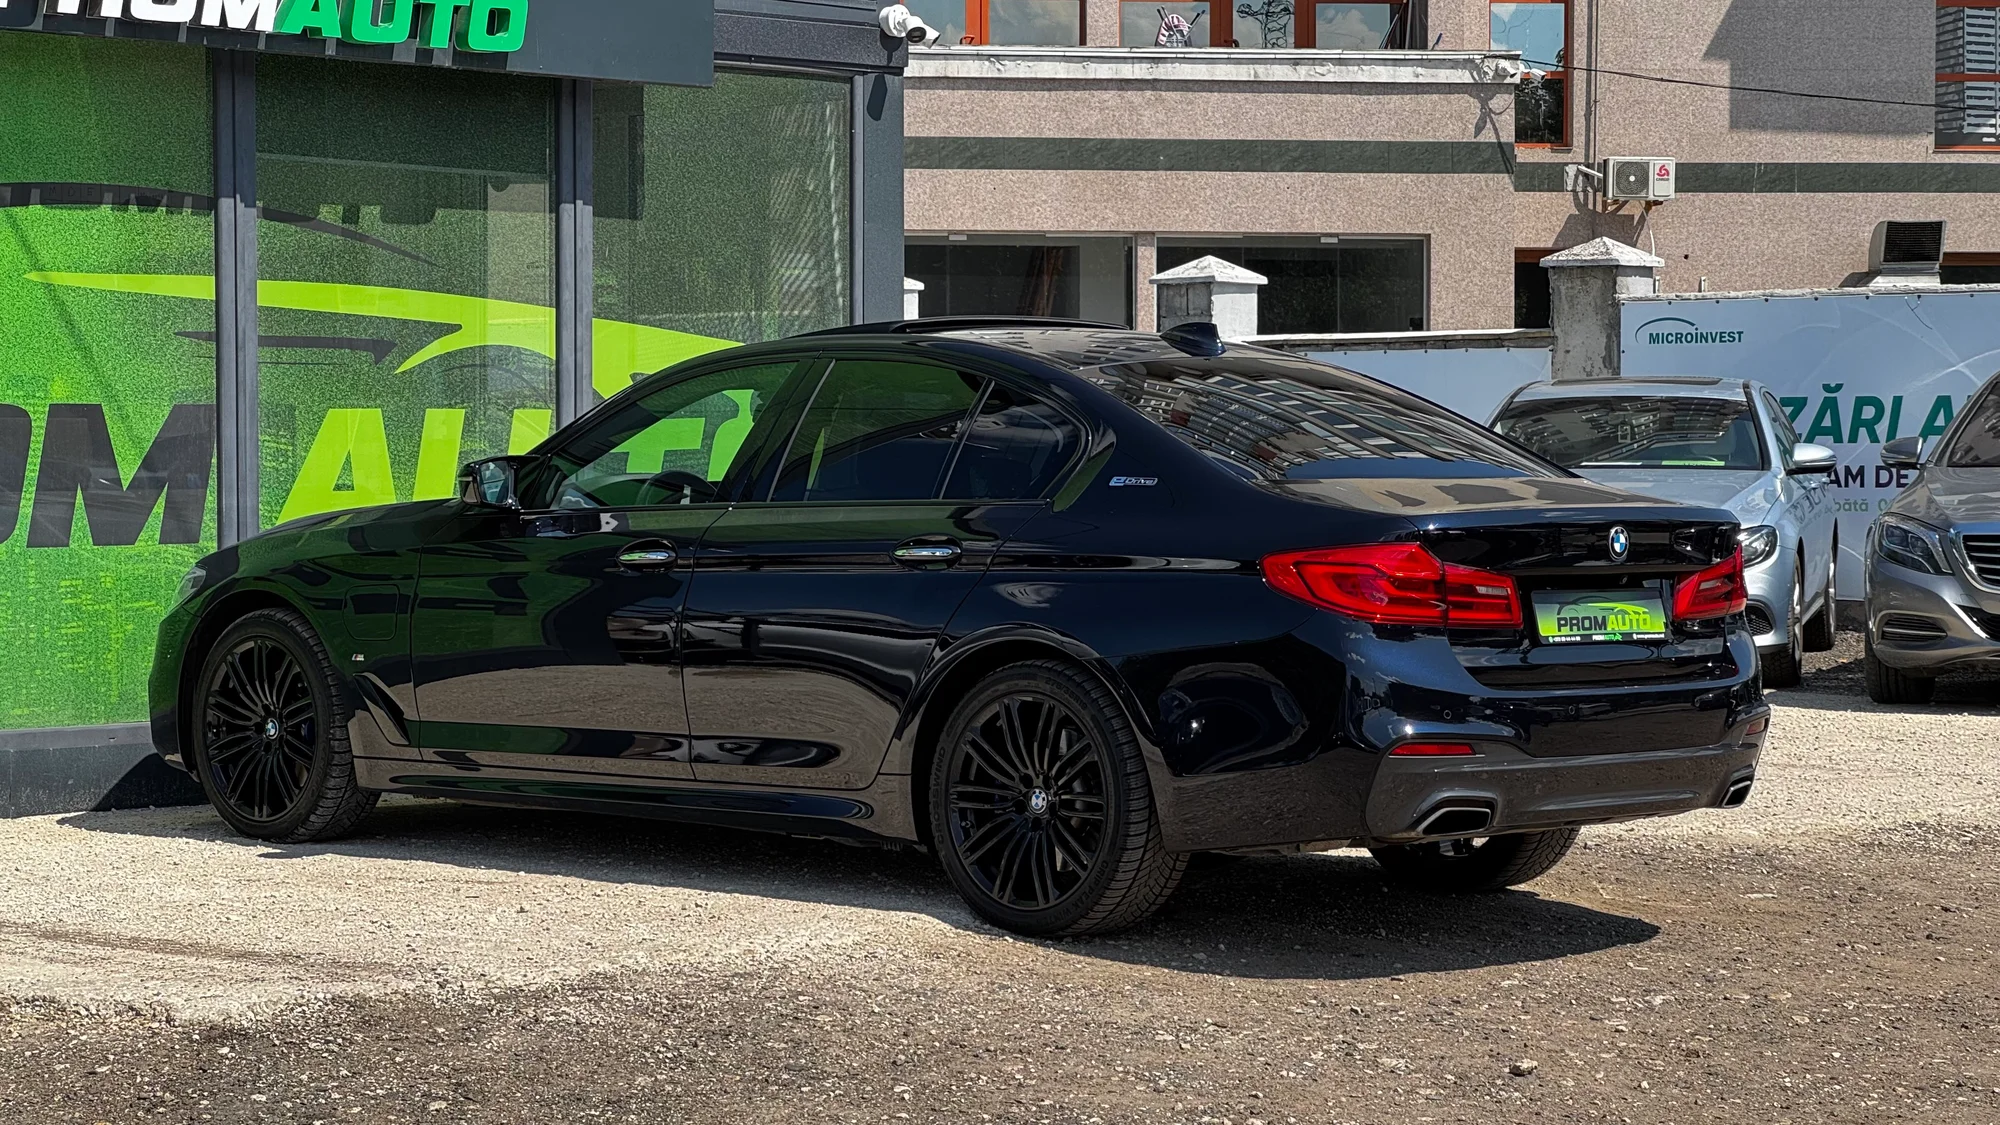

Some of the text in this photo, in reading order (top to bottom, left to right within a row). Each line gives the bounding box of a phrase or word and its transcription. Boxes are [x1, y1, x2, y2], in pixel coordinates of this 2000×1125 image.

[0, 0, 528, 52] MAUTO
[1779, 383, 1977, 444] ZĂRI A
[1827, 465, 1910, 489] AM DE
[1556, 614, 1651, 633] PROMAUTO
